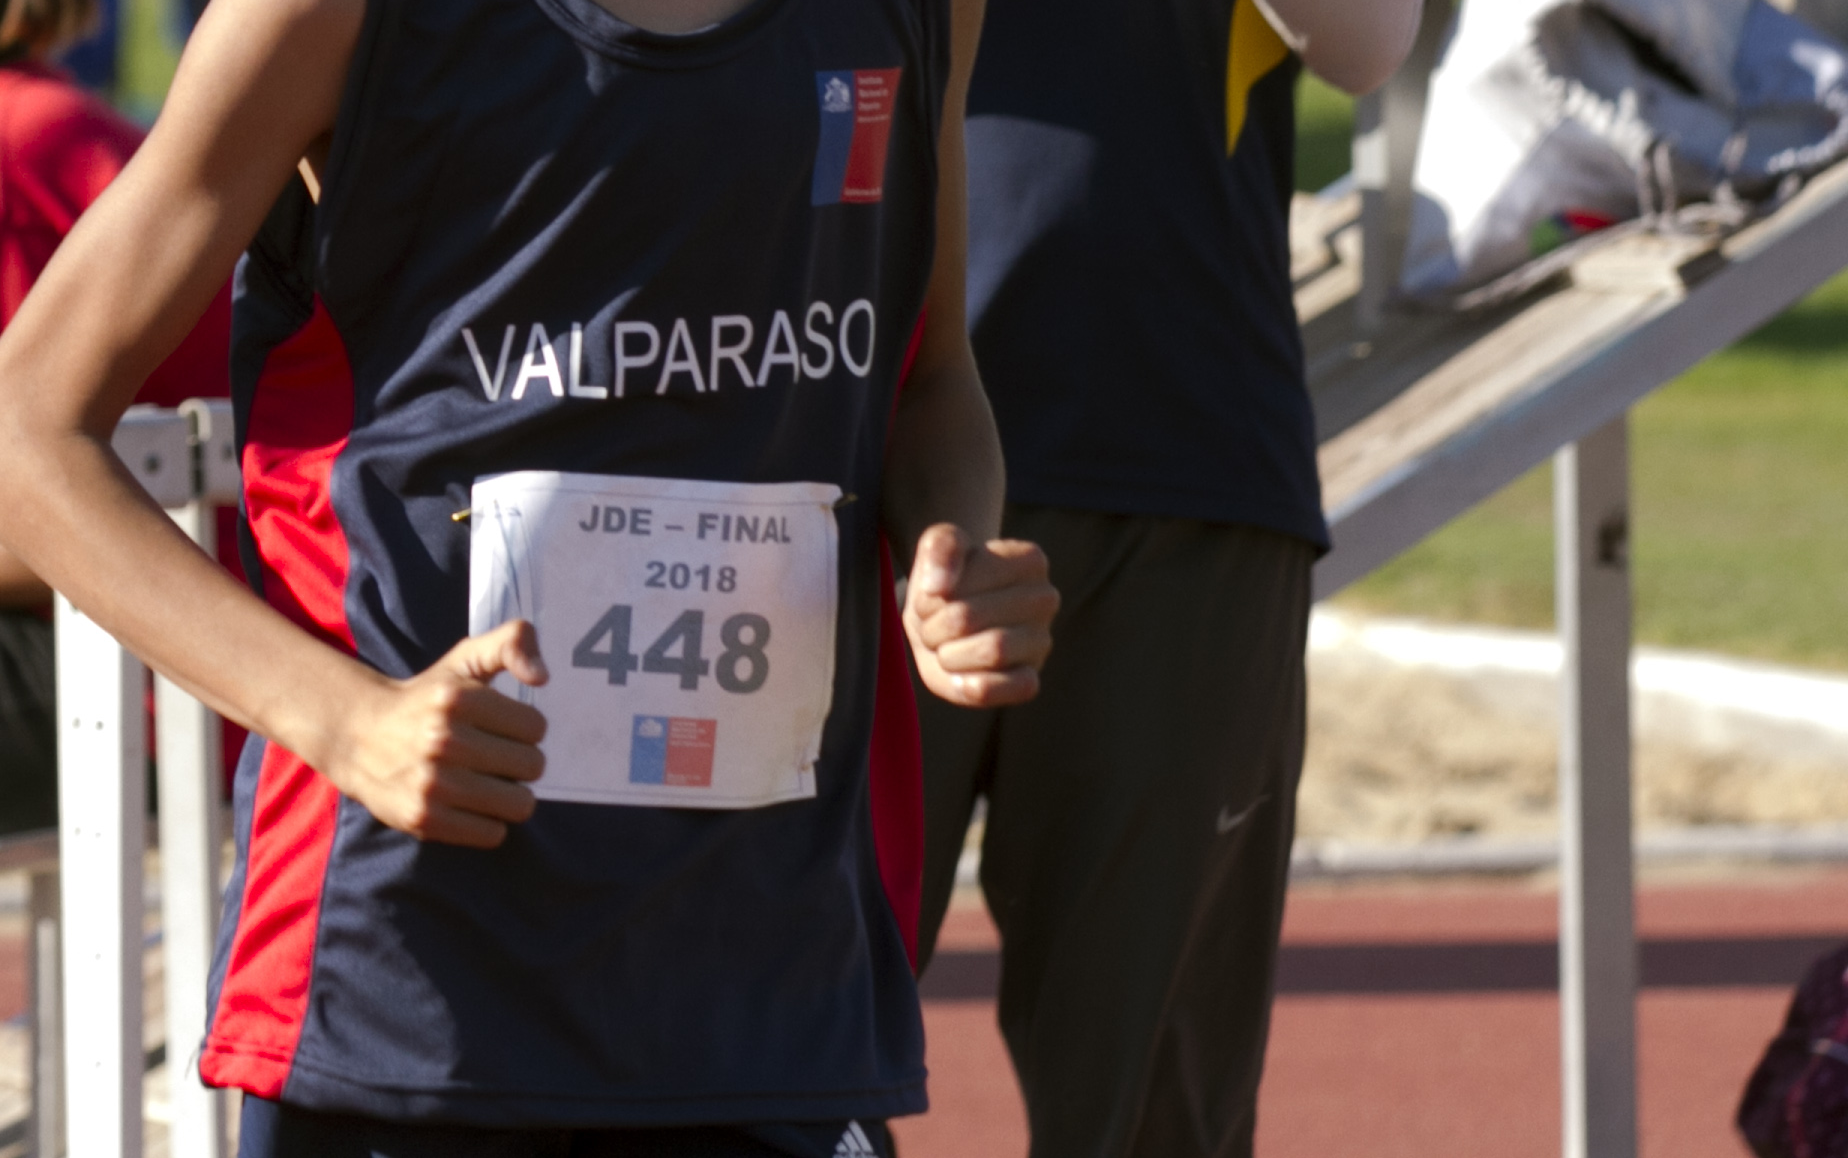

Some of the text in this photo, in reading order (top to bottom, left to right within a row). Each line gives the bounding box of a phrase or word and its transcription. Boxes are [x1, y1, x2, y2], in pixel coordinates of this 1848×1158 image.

[461, 298, 877, 402] VALPARASO
[579, 505, 653, 537] JDE
[696, 512, 791, 544] FINAL
[643, 560, 738, 593] 2018
[570, 602, 772, 694] 448
